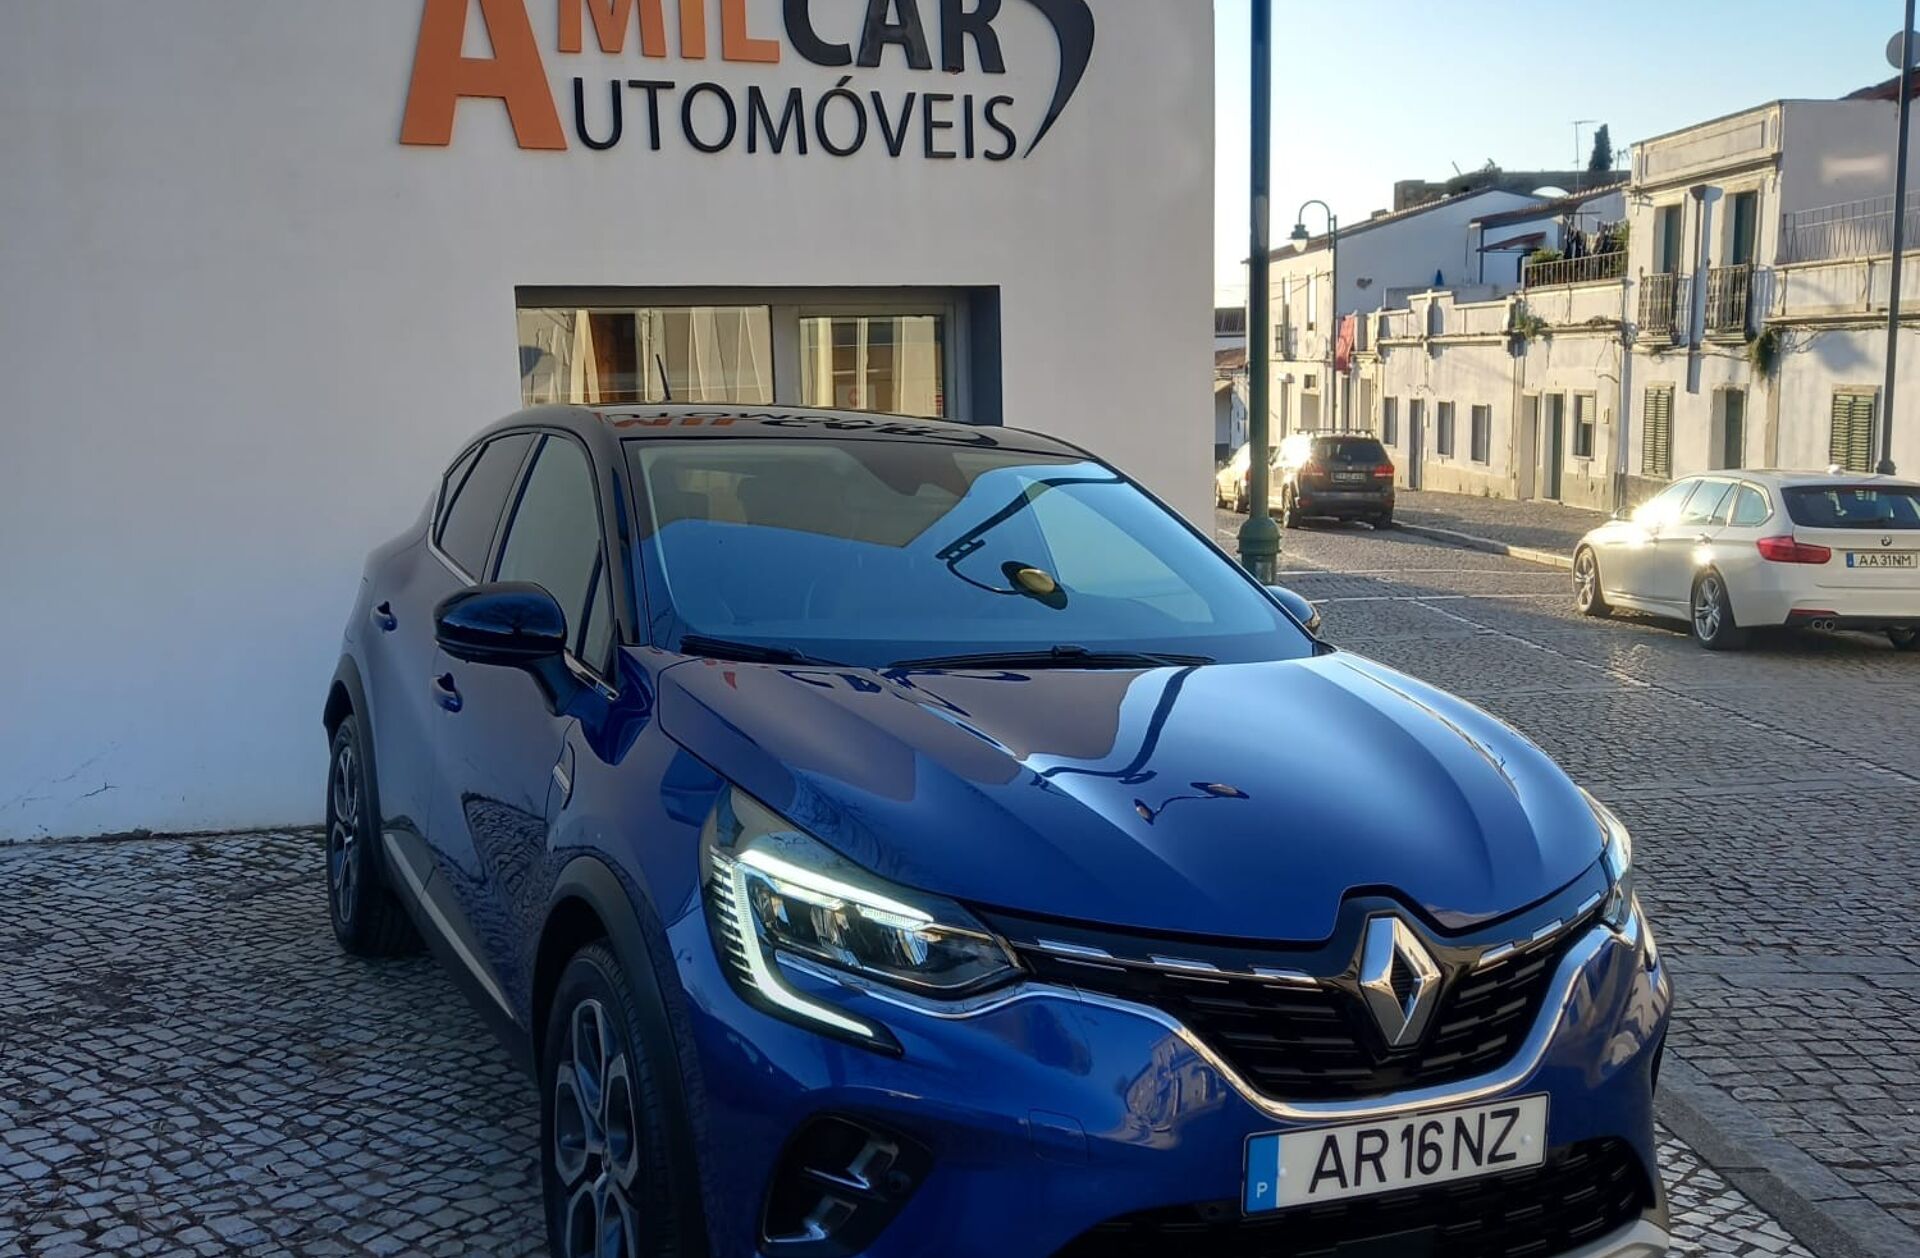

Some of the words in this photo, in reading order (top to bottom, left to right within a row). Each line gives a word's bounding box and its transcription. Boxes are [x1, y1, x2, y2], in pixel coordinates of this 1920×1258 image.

[1859, 554, 1912, 566] AA31NM
[1256, 1182, 1268, 1198] P
[1308, 1107, 1520, 1193] AR16NZ
